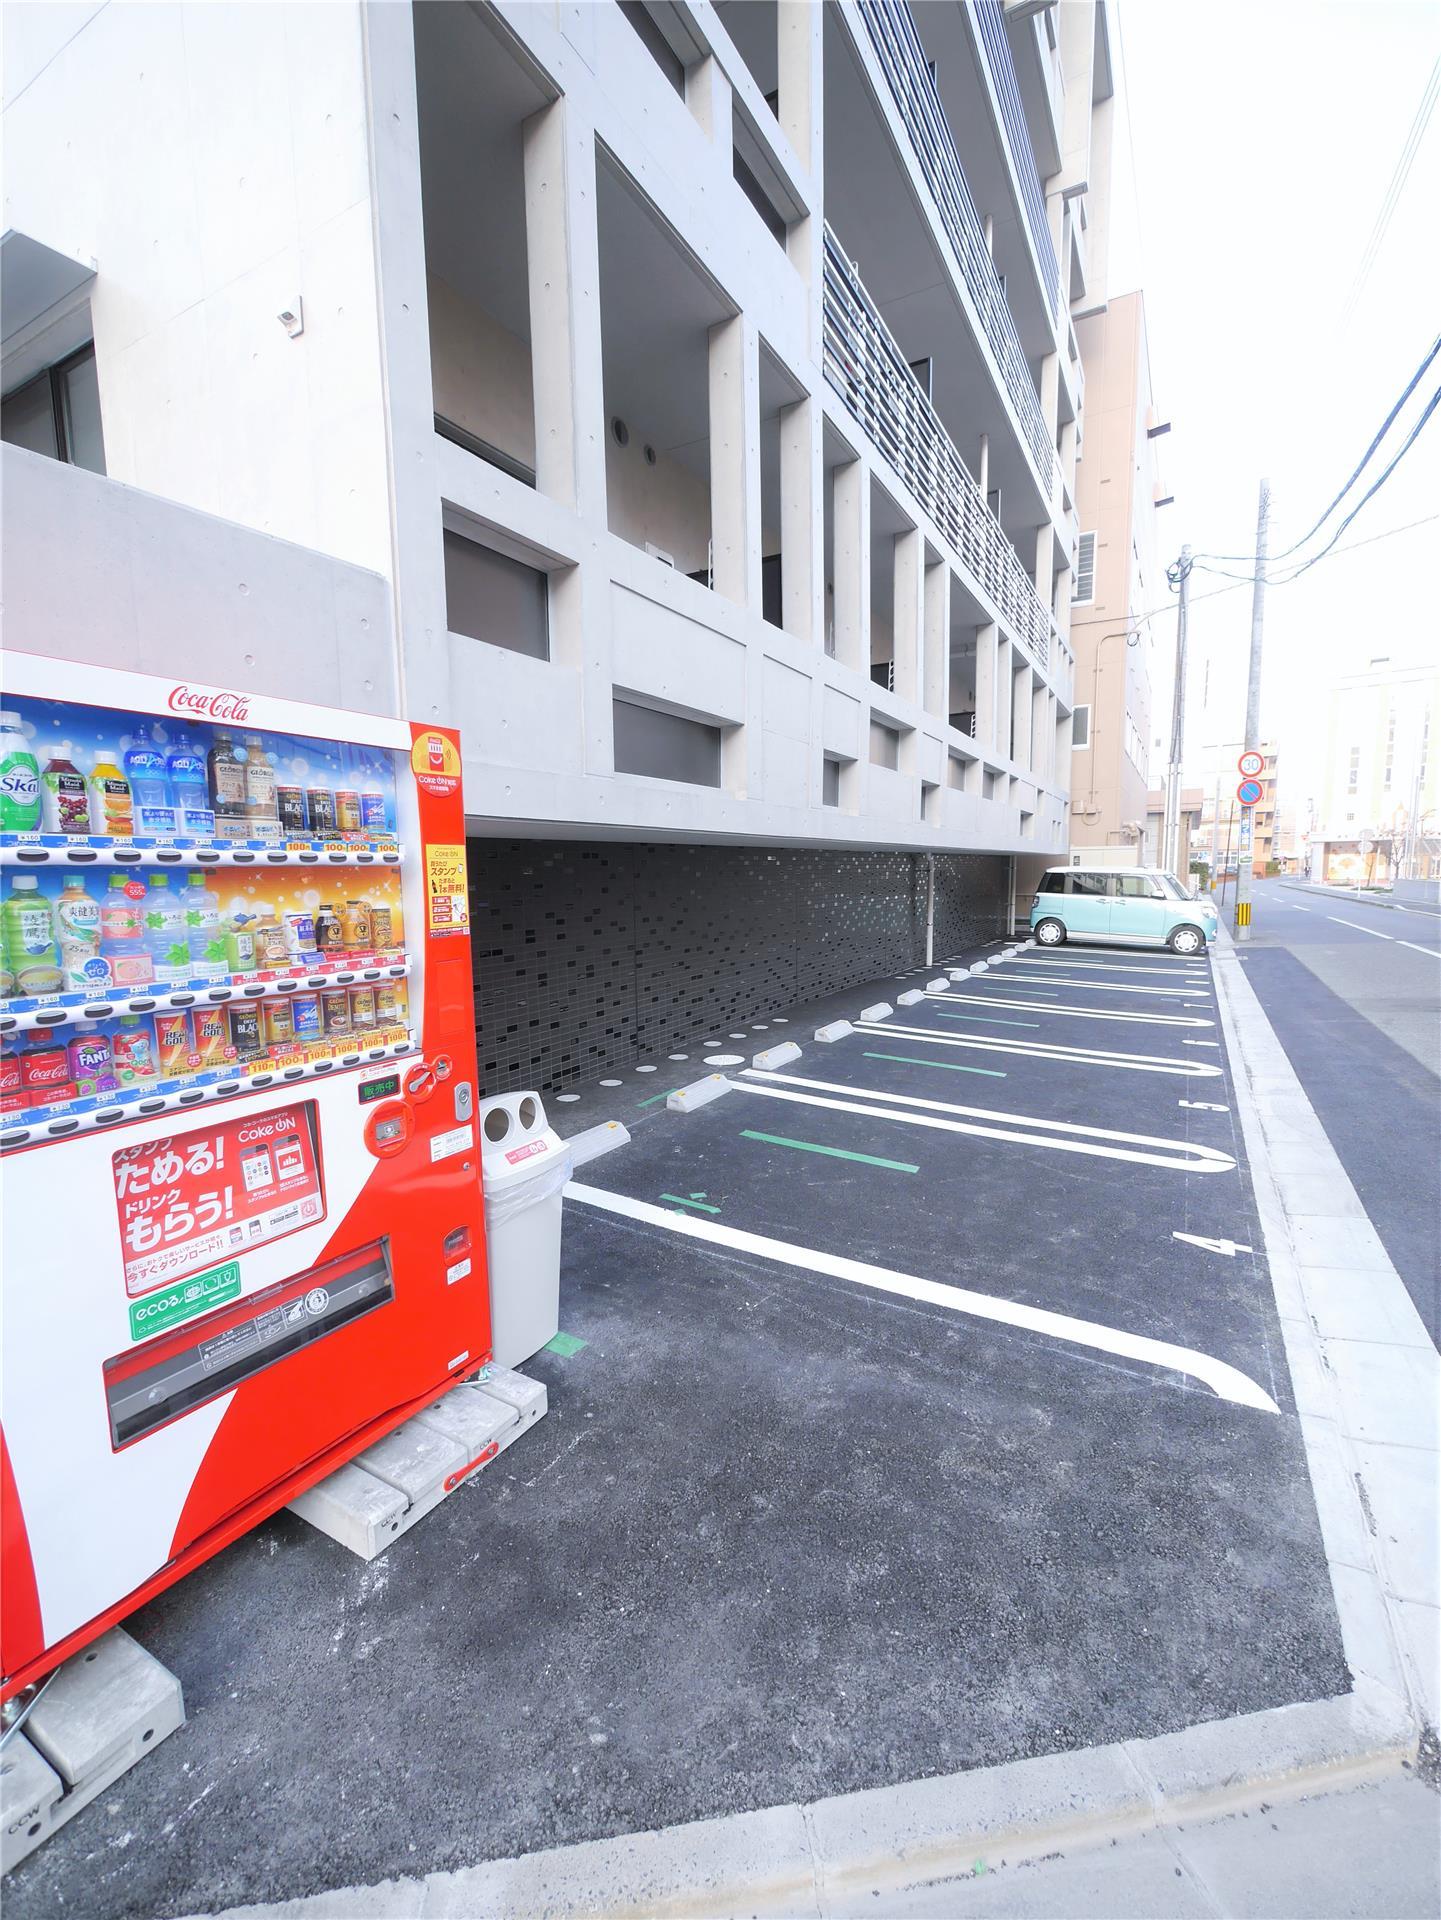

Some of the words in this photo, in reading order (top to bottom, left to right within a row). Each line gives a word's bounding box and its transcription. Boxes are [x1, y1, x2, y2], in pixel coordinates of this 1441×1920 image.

[167, 685, 251, 722] Coca-Cola
[1243, 758, 1259, 771] 30
[431, 867, 457, 876] スタンプ
[364, 1080, 395, 1097] 販売中
[238, 1125, 274, 1143] Coke
[275, 1117, 296, 1132] ON
[115, 1135, 225, 1199] ためる!
[125, 1189, 181, 1219] ドリンク
[126, 1185, 234, 1252] もらう!
[1172, 1231, 1253, 1257] 4
[7, 1804, 41, 1835] CCW
